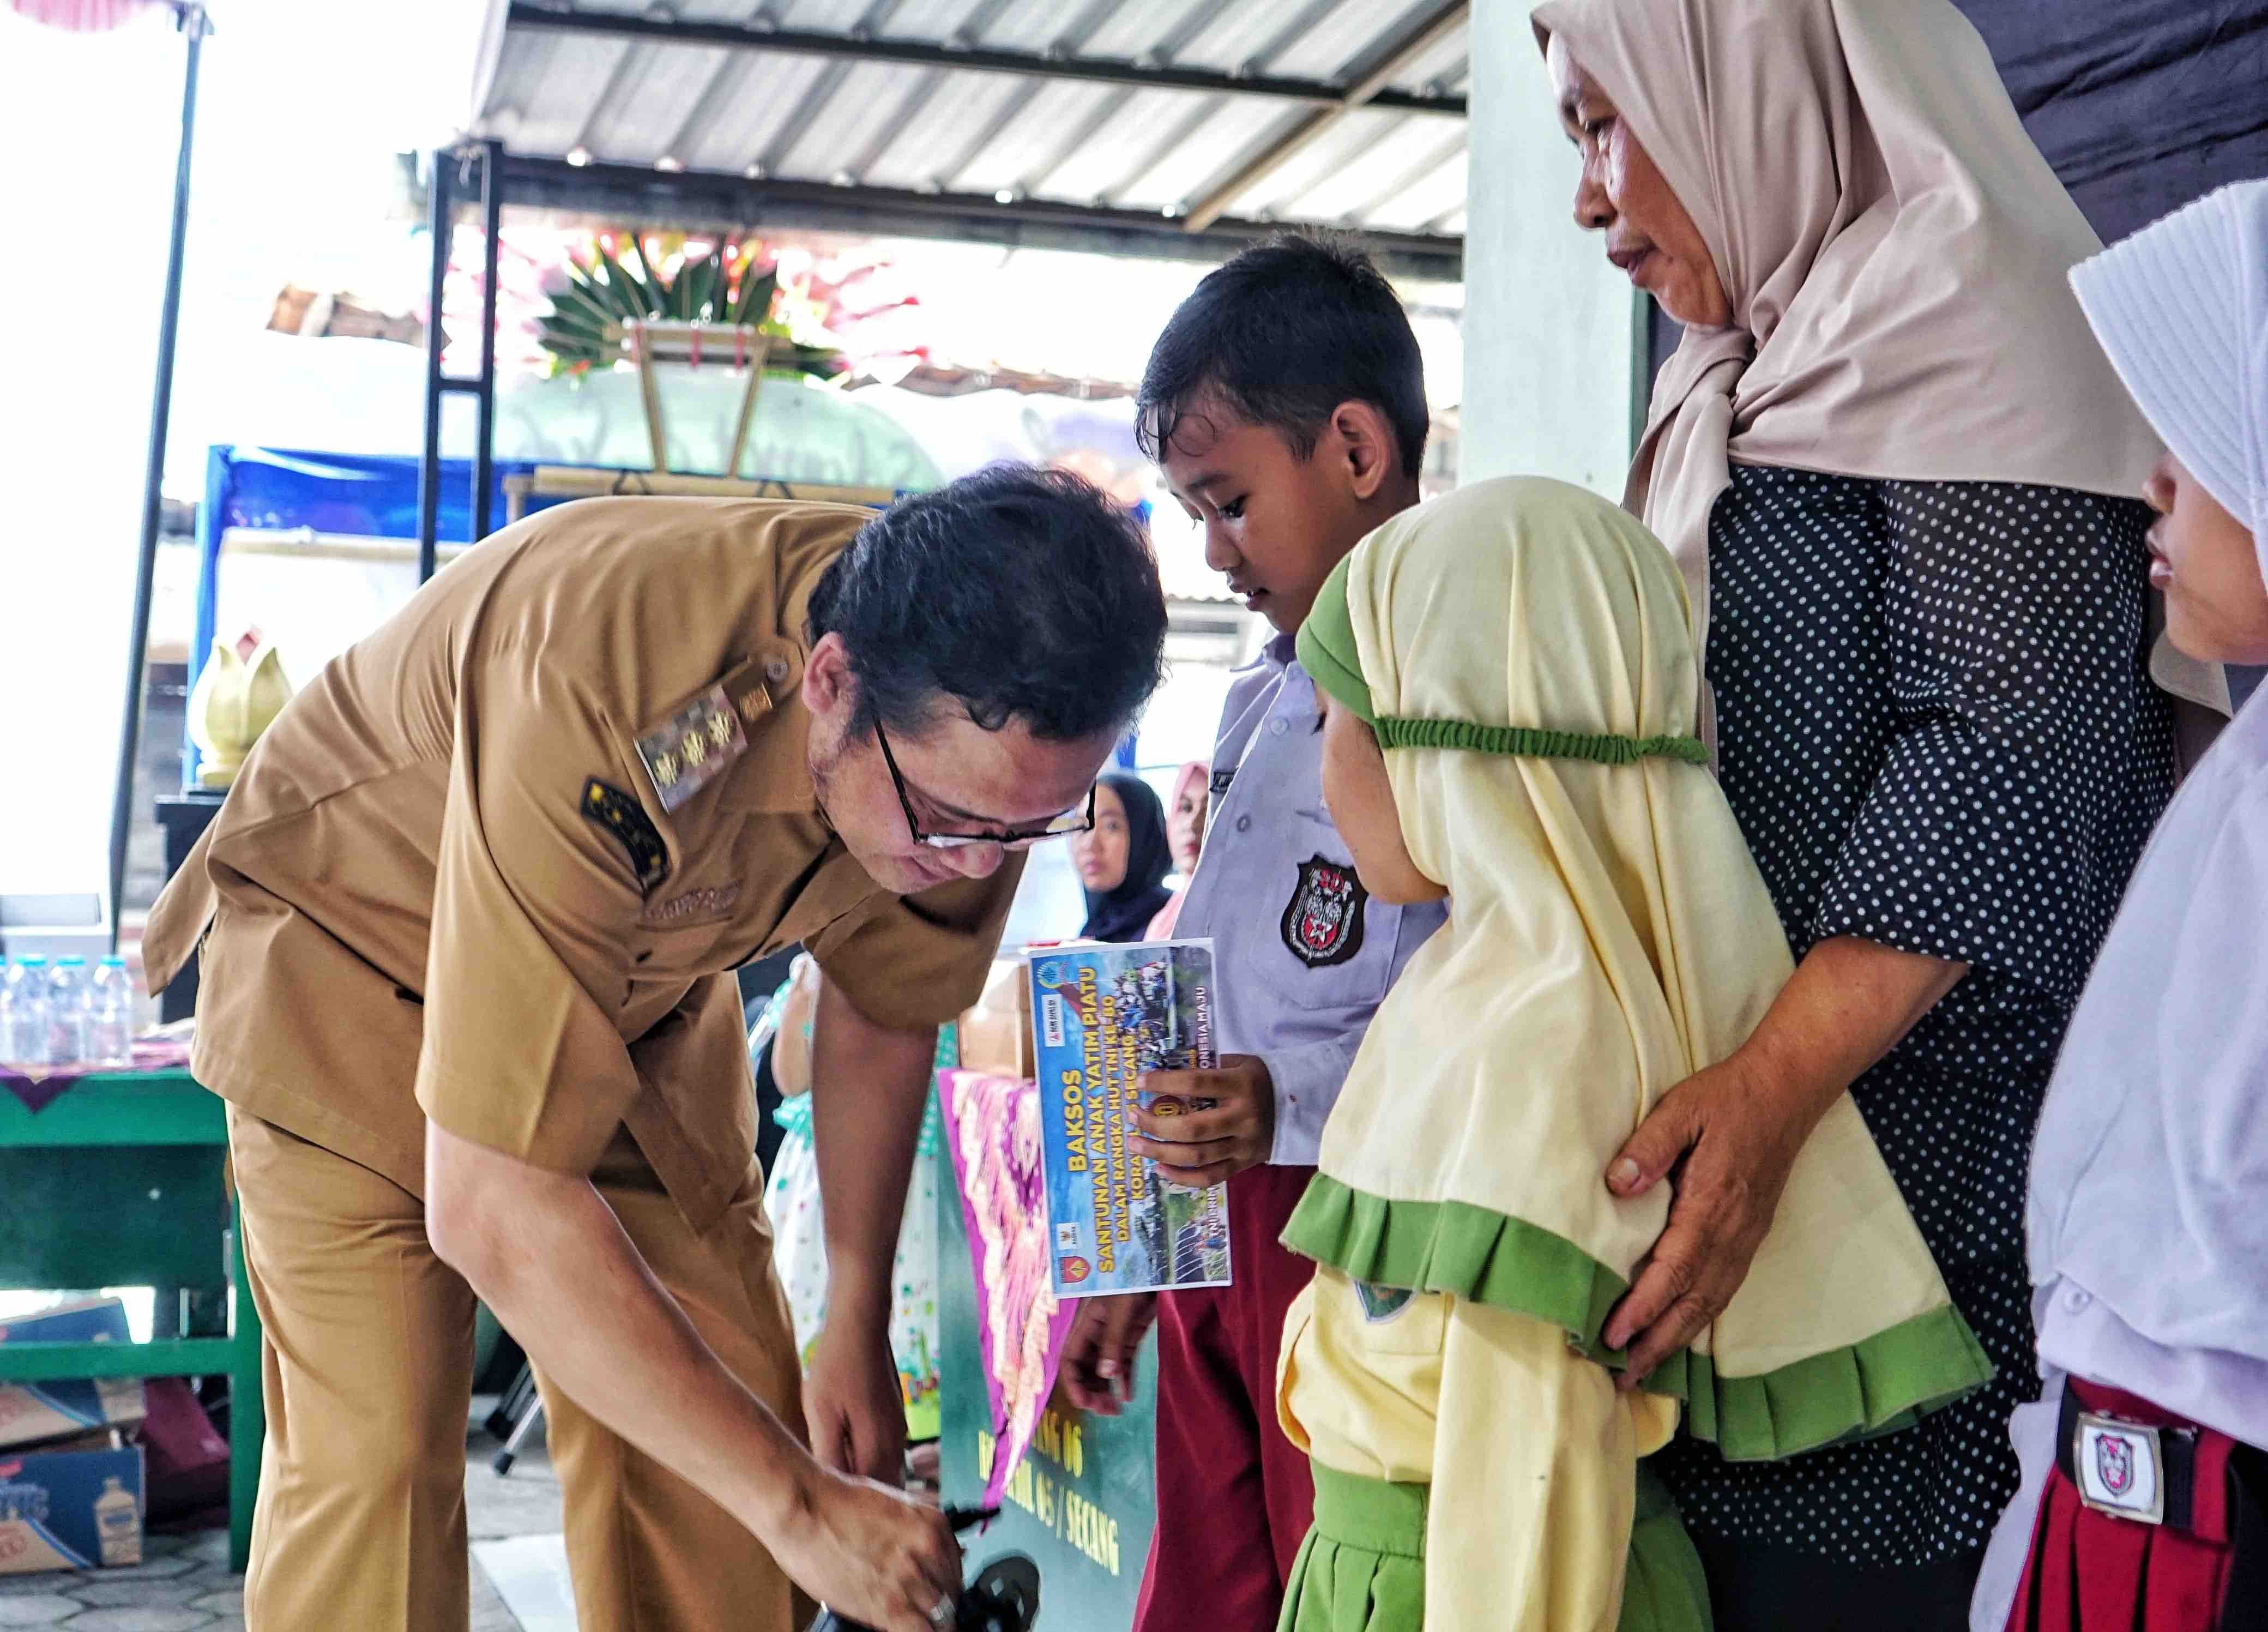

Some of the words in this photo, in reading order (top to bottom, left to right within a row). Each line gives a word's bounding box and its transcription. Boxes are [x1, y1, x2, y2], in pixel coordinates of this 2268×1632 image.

[1078, 967, 1100, 1026] PIATU
[1195, 986, 1209, 1022] MAJU
[1083, 1031, 1102, 1092] YATIM
[1103, 1049, 1120, 1076] TNI
[1121, 1035, 1139, 1100] SECANG
[1061, 1069, 1088, 1172] BAKSOS
[1087, 1095, 1107, 1154] ANAK
[1106, 1077, 1122, 1111] HUT
[1108, 1113, 1126, 1181] RANGKA
[1126, 1128, 1144, 1200] KORAL
[1091, 1158, 1115, 1273] SANTUNAN
[1112, 1183, 1130, 1242] DALAM
[1066, 1490, 1120, 1577] SECANG
